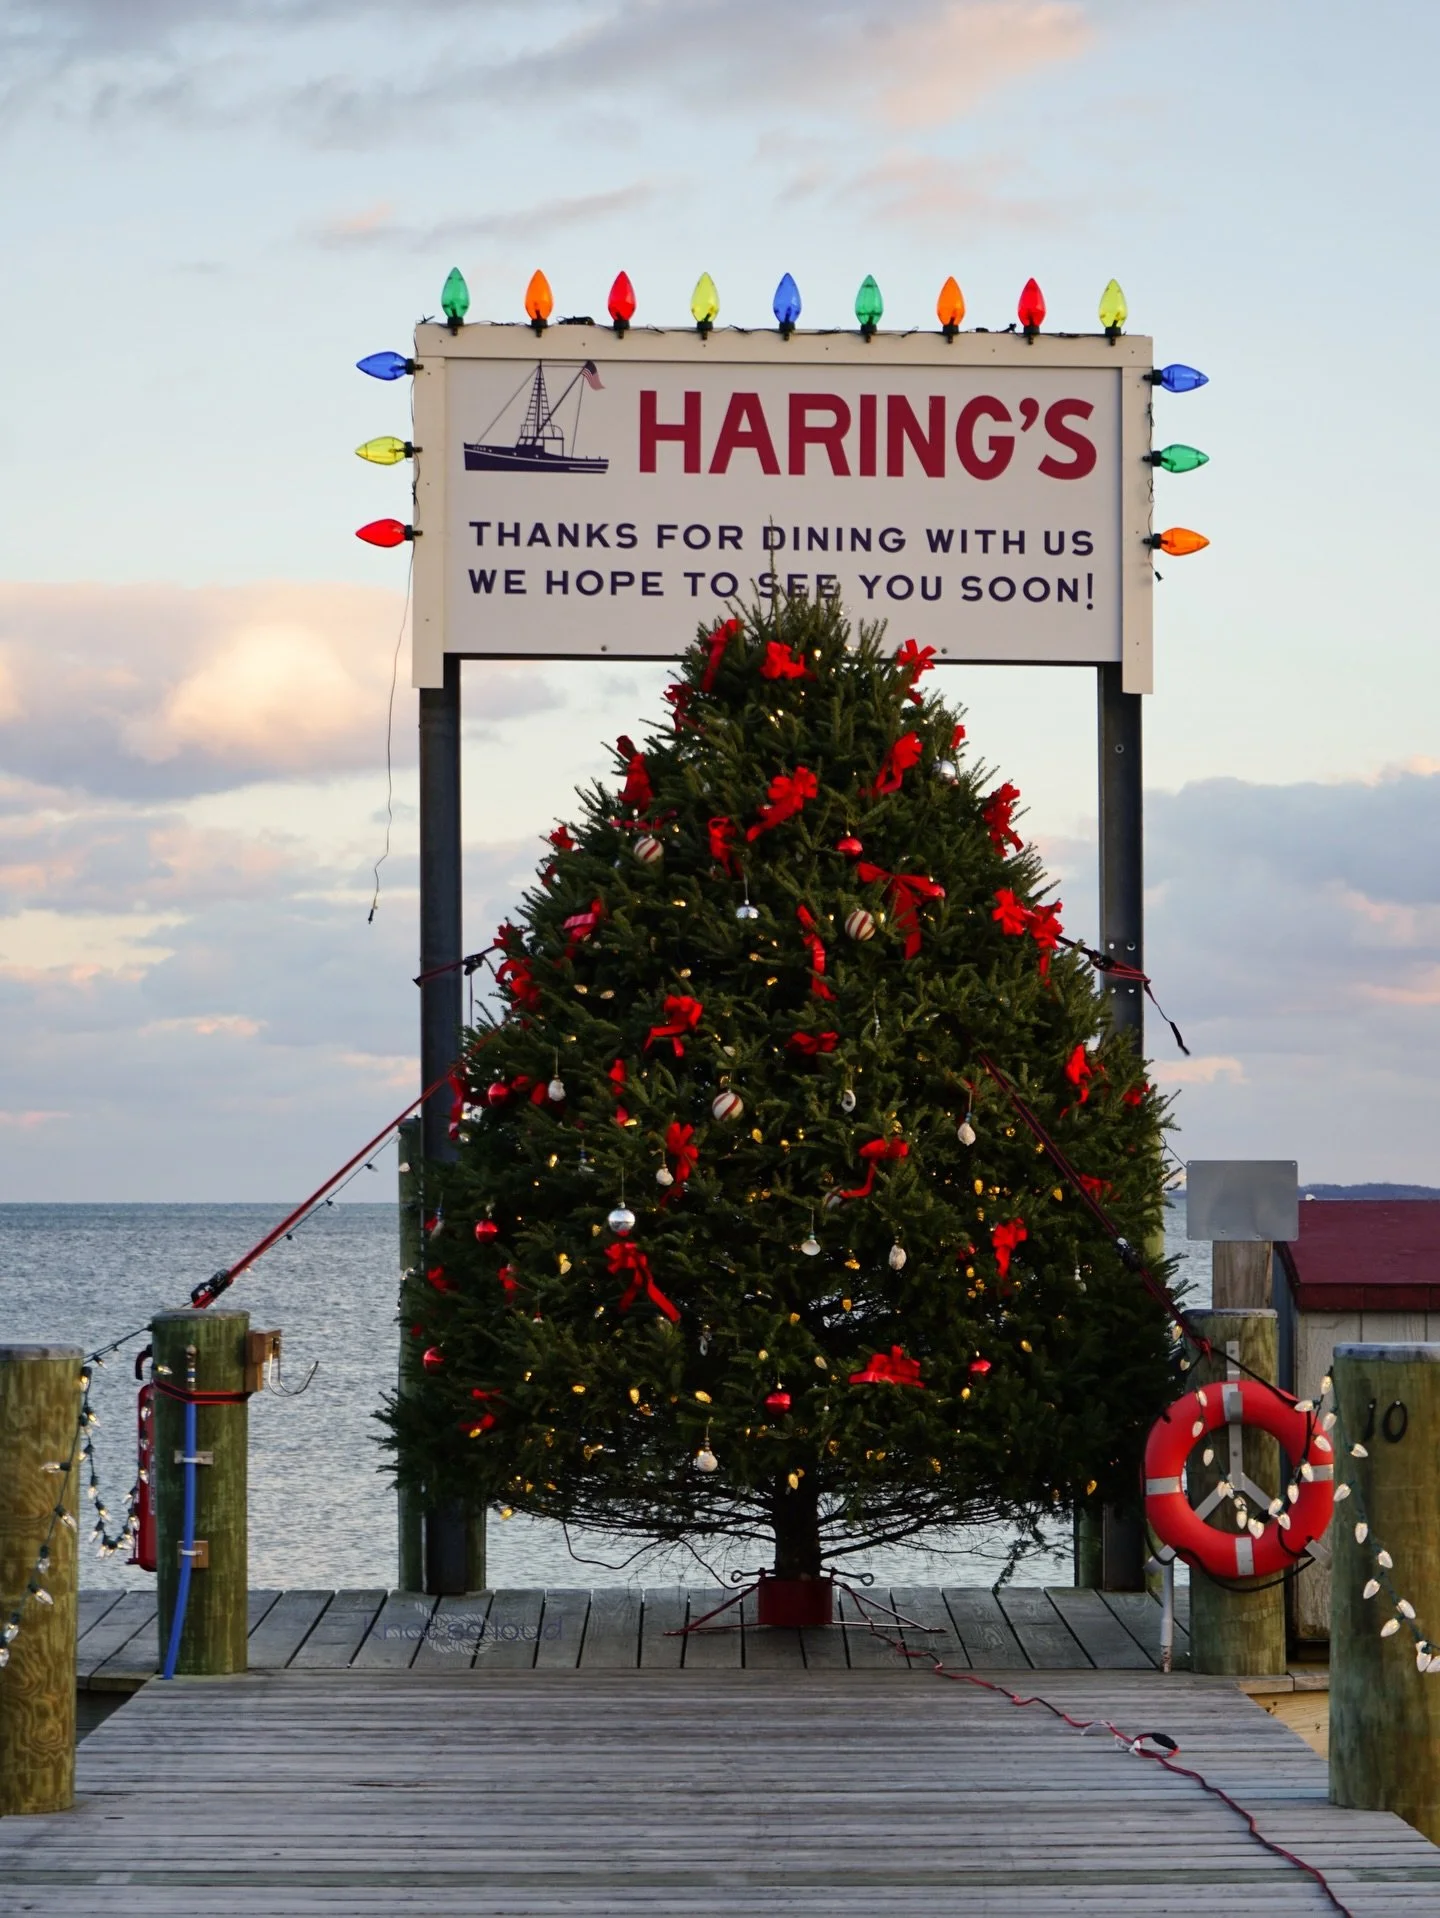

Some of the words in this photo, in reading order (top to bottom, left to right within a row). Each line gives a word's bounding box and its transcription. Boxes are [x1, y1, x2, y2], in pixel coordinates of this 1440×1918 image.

[640, 391, 1096, 480] HARING'S
[469, 522, 637, 548] THANKS
[658, 524, 743, 550] FOR
[763, 526, 906, 555] DINING
[926, 529, 1025, 555] WITH
[1044, 531, 1094, 556] US
[469, 569, 527, 595] WE
[546, 570, 664, 597] HOPE
[683, 572, 739, 598] TO
[758, 573, 839, 599] SEE
[859, 575, 942, 601] YOU
[962, 573, 1094, 610] SOON!
[1363, 1398, 1408, 1443] 10
